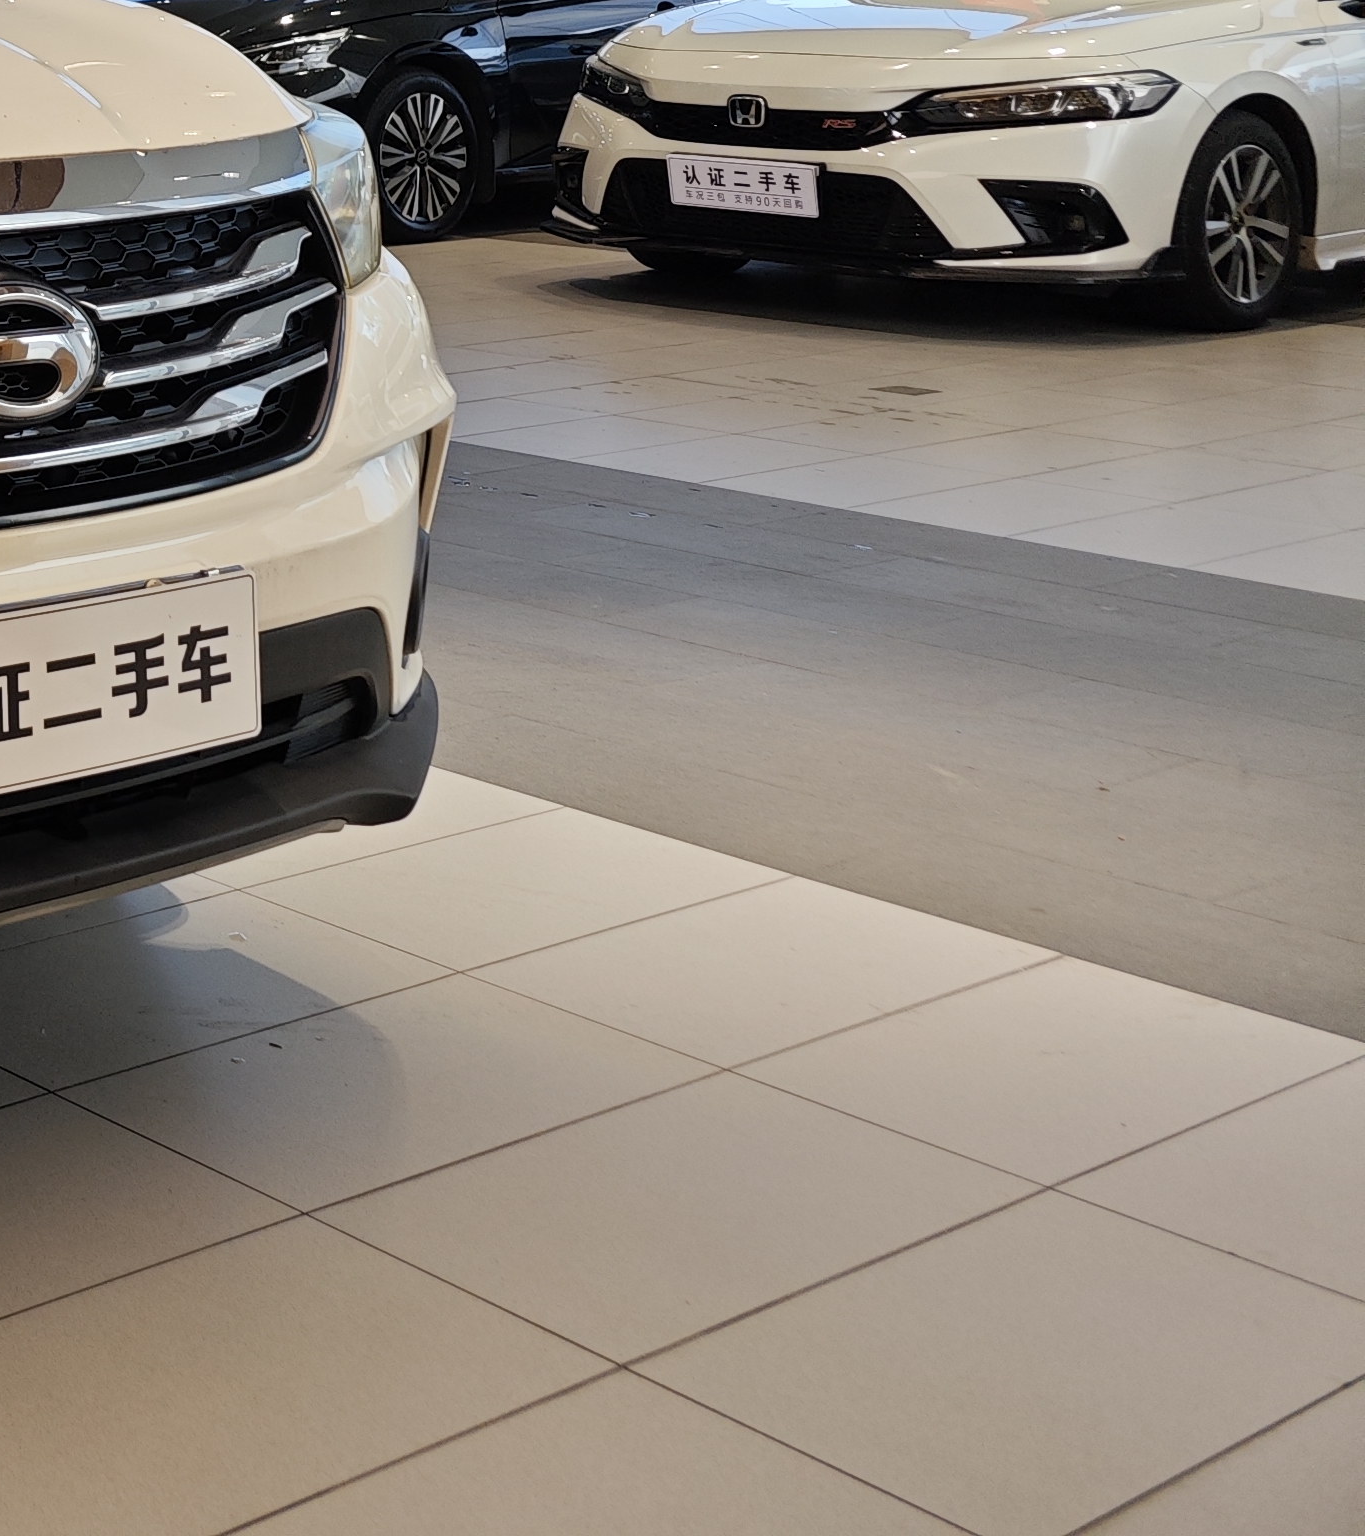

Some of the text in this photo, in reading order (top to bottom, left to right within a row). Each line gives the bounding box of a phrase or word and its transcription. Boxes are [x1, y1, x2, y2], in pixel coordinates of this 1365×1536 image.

[821, 118, 857, 129] RS
[682, 164, 802, 195] 认证二手车
[685, 189, 804, 210] 车况三包 支持90天回购
